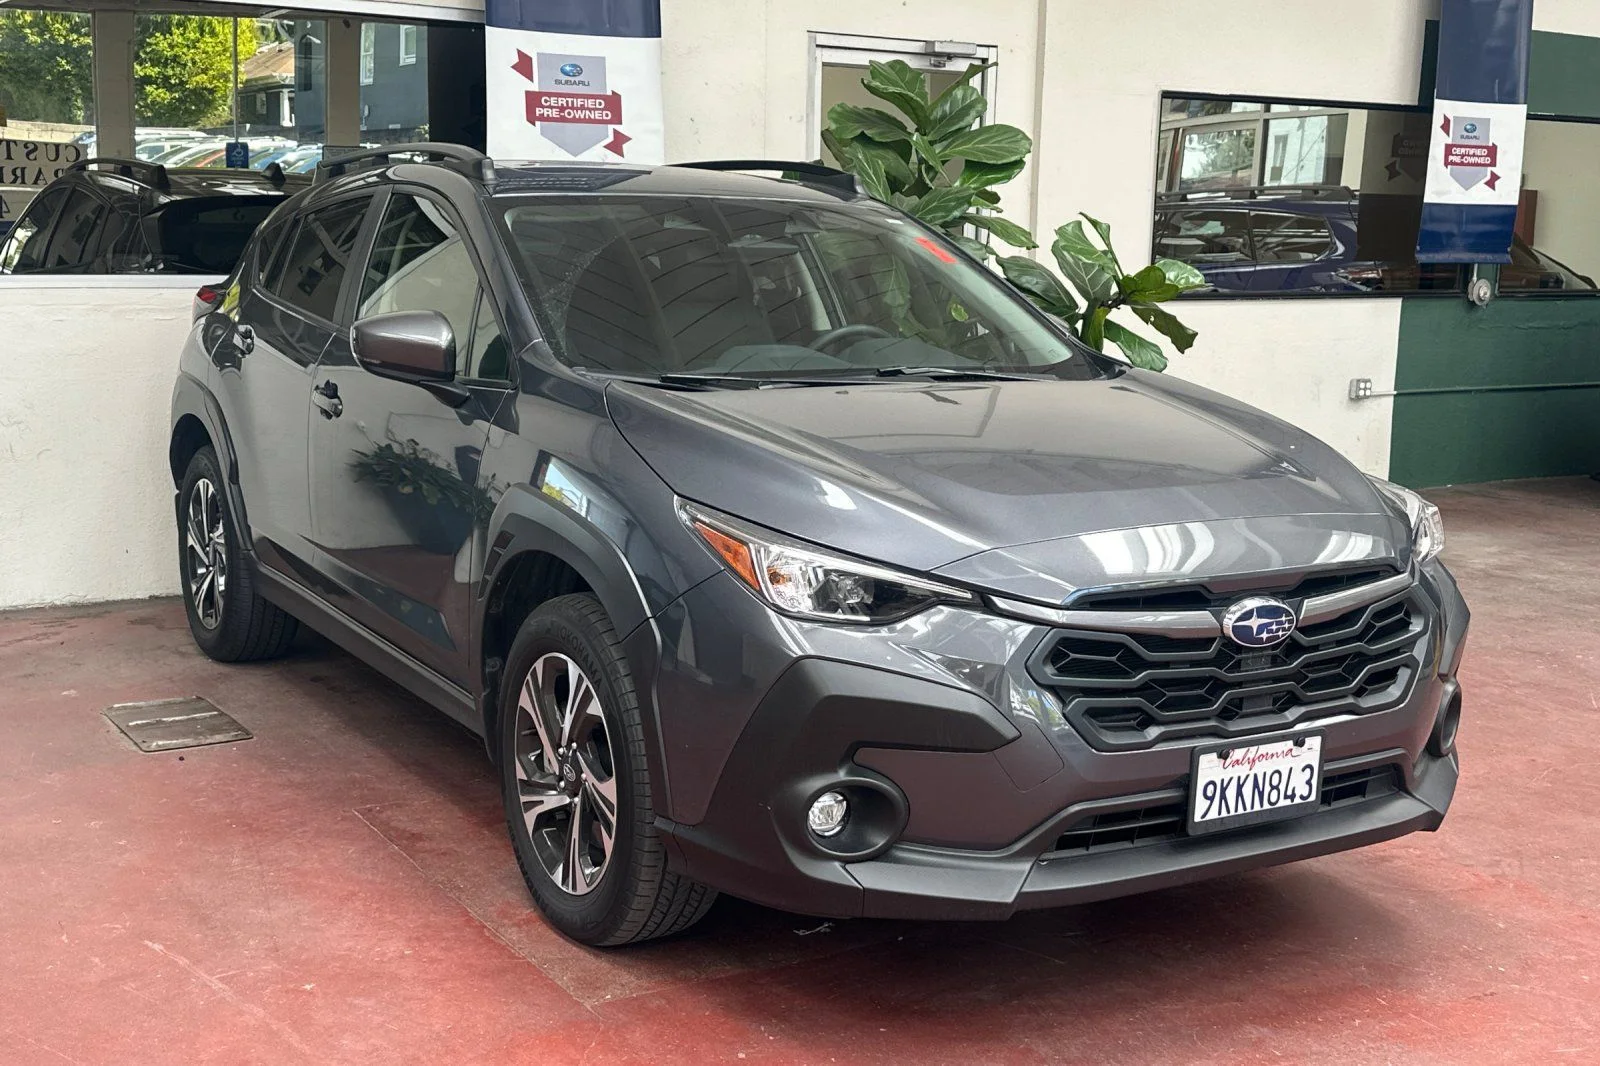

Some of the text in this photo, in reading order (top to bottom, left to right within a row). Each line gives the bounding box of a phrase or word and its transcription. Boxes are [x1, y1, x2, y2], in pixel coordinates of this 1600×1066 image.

[554, 78, 590, 87] SUBARU
[541, 96, 605, 109] CERTIFIED
[535, 107, 612, 120] PRE-OWNED
[1451, 147, 1488, 156] CERTIFIED
[1448, 155, 1491, 164] PRE-OWNED
[1222, 746, 1299, 771] California
[1200, 763, 1315, 820] 9KKN843
